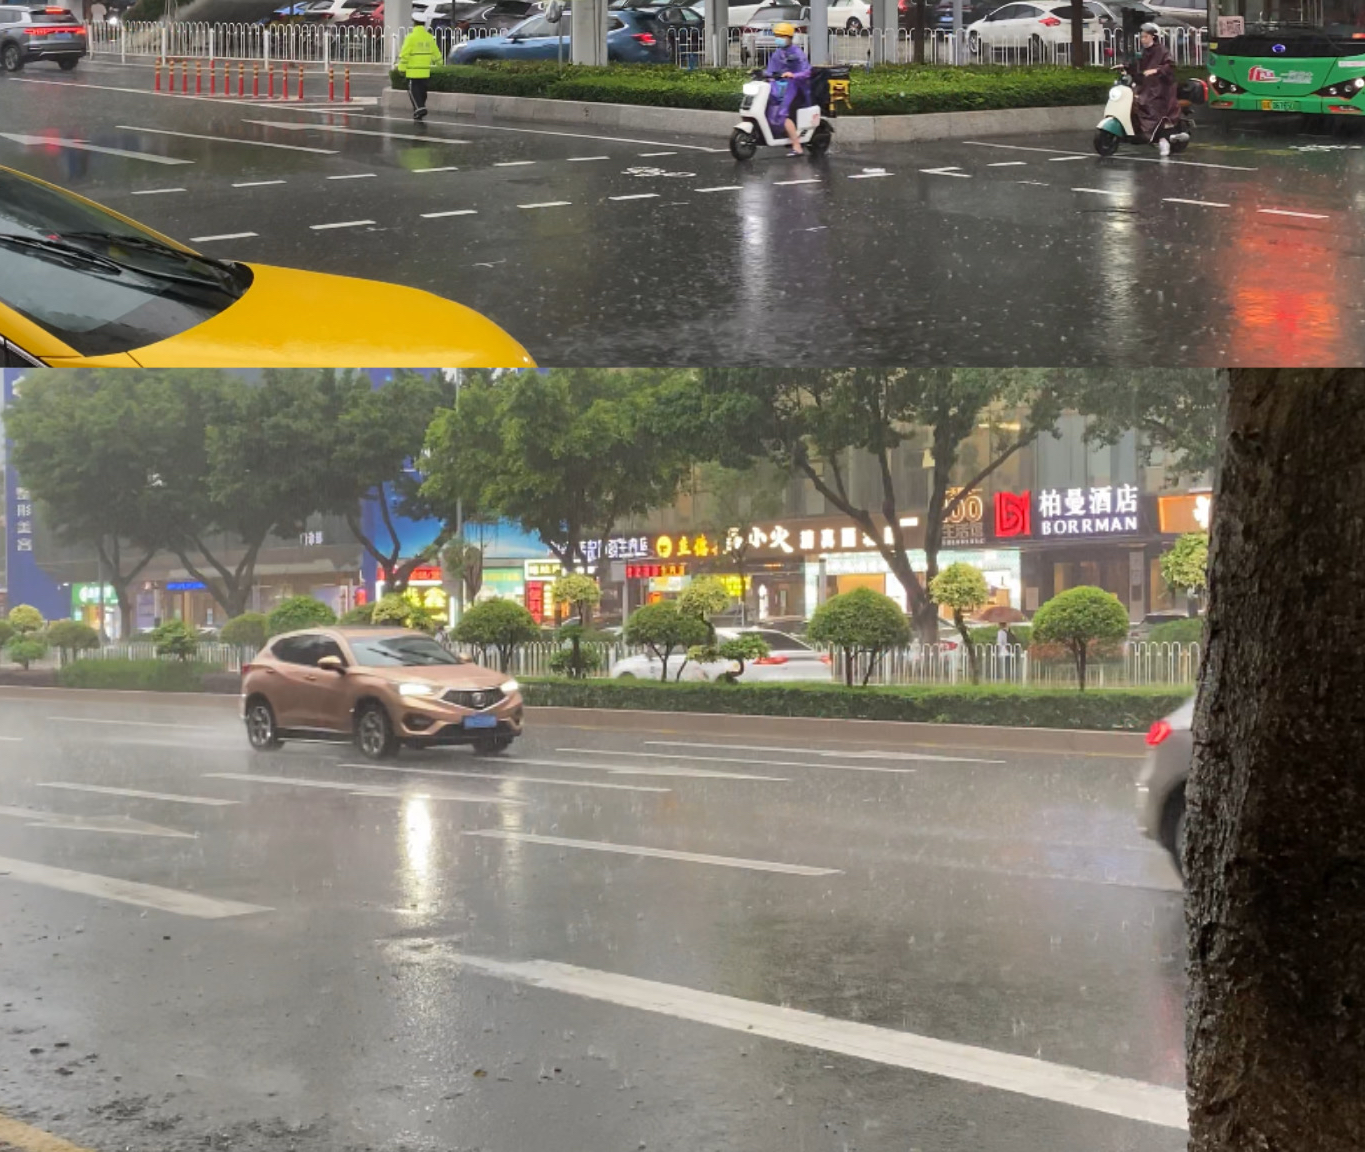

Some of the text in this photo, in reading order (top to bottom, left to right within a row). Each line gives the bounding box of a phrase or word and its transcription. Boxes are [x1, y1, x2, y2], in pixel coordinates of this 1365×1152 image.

[1038, 483, 1139, 518] 柏曼酒店
[1041, 516, 1138, 536] BORRMAN
